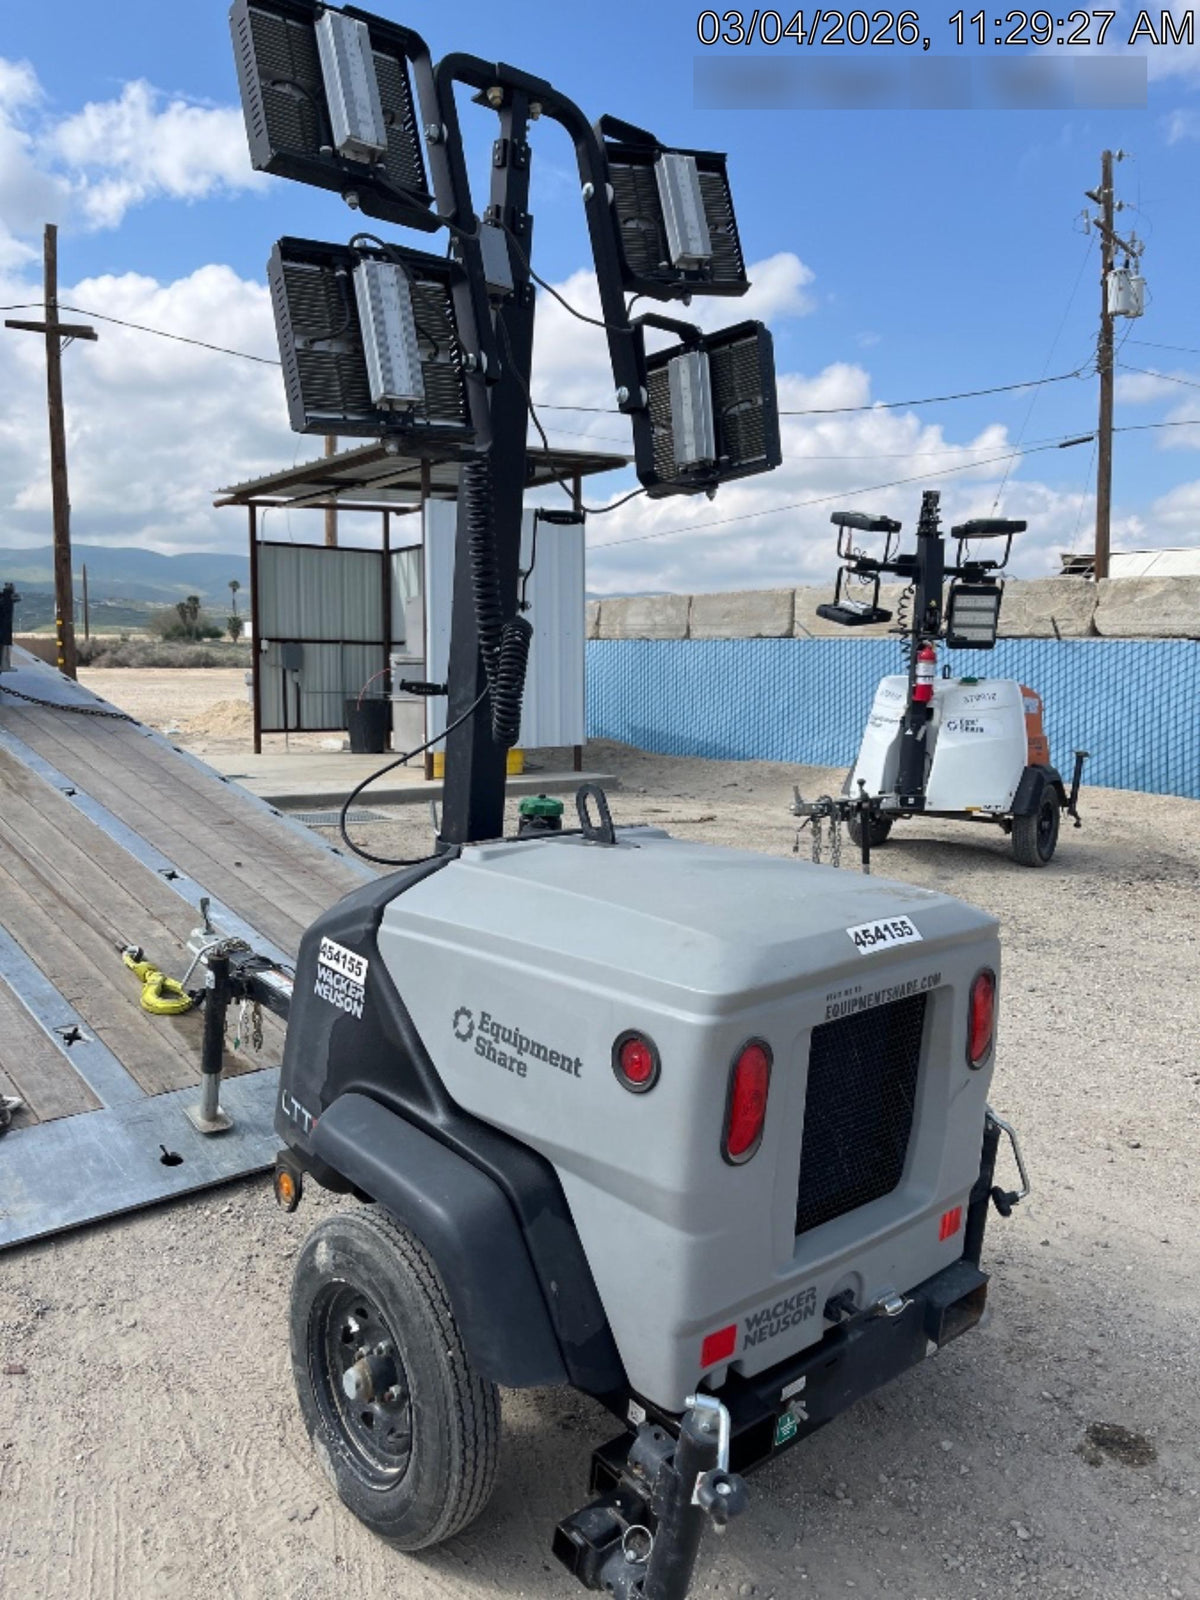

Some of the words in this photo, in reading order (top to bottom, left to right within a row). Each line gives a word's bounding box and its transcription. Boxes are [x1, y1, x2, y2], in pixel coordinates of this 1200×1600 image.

[854, 920, 914, 948] 454155
[320, 942, 363, 978] 454155
[314, 979, 364, 1020] NEUSON
[317, 963, 366, 1004] WACKER
[825, 972, 942, 1020] EQUIPMENTSHARE.COM
[474, 1035, 528, 1079] Share
[477, 1010, 584, 1079] Equipment
[743, 1302, 817, 1351] NEUSON
[744, 1286, 817, 1329] WACKER
